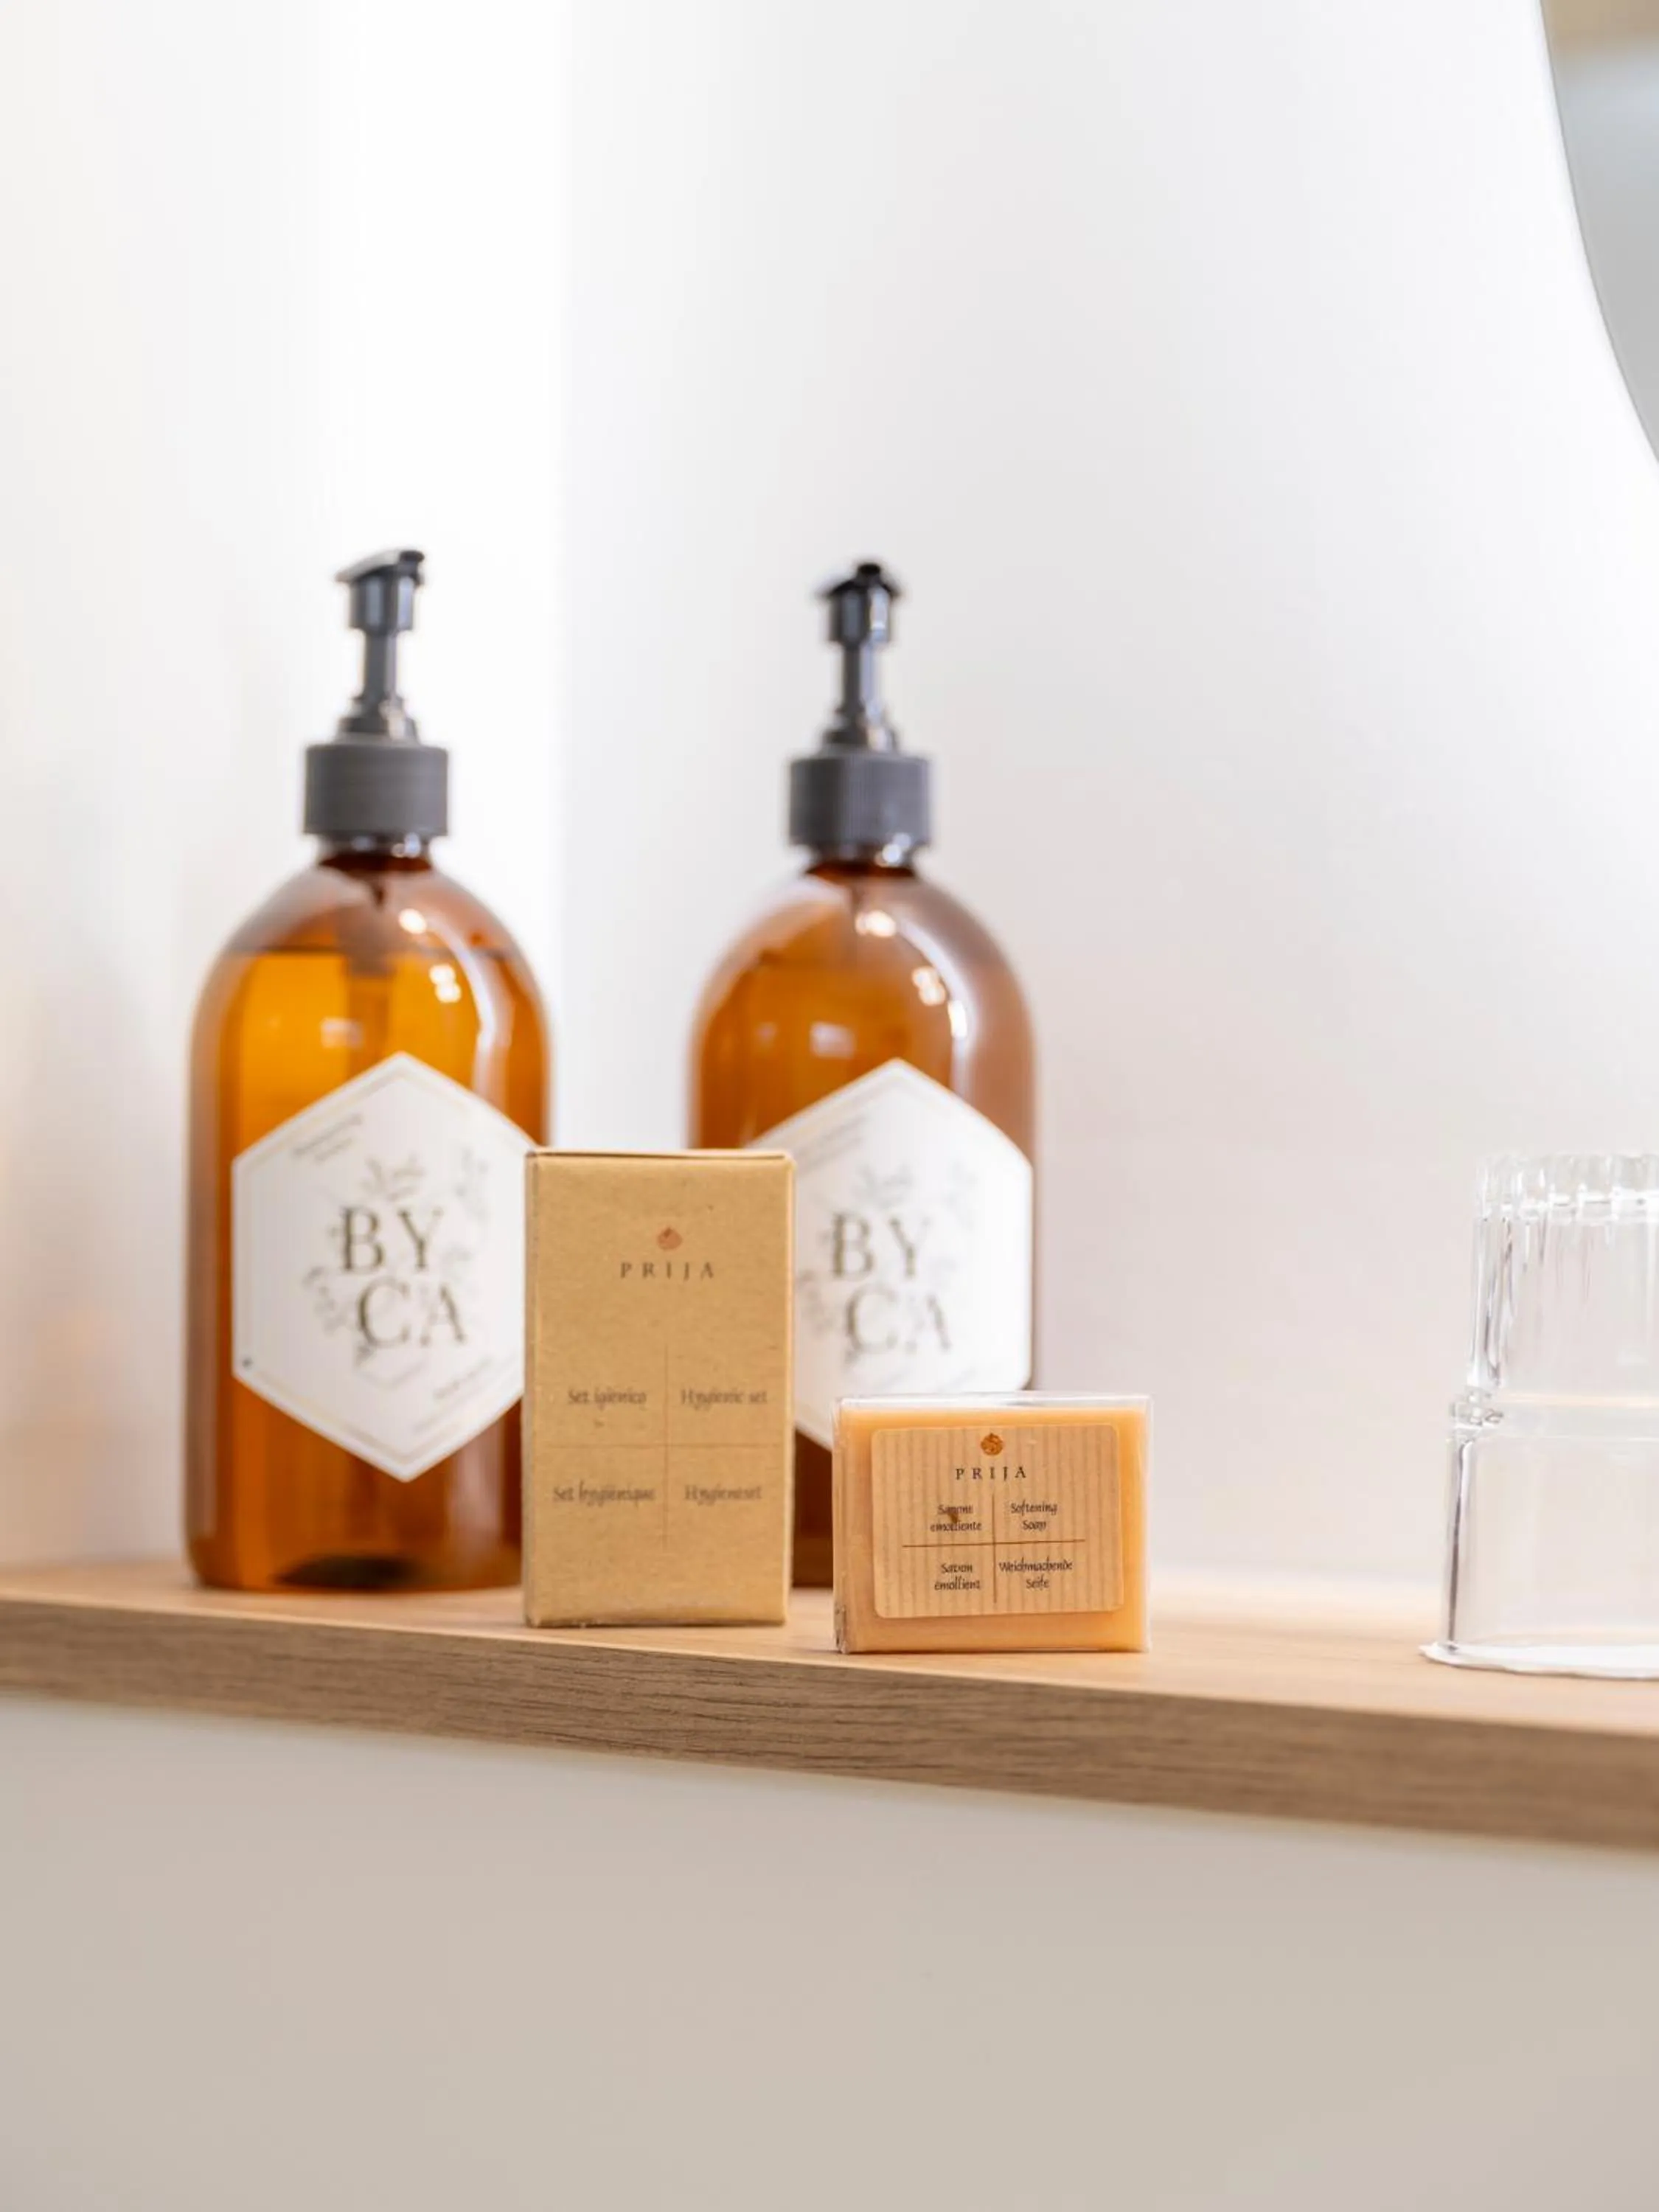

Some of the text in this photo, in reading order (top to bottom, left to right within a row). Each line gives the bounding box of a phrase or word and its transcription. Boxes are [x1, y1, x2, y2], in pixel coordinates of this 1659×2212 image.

[341, 1206, 443, 1273] BY
[831, 1212, 931, 1279] BY
[620, 1262, 714, 1281] PRIJA
[357, 1276, 467, 1347] CA
[956, 1467, 1027, 1481] PRIJA
[1010, 1499, 1058, 1516] Softening
[1026, 1574, 1050, 1591] Seife
